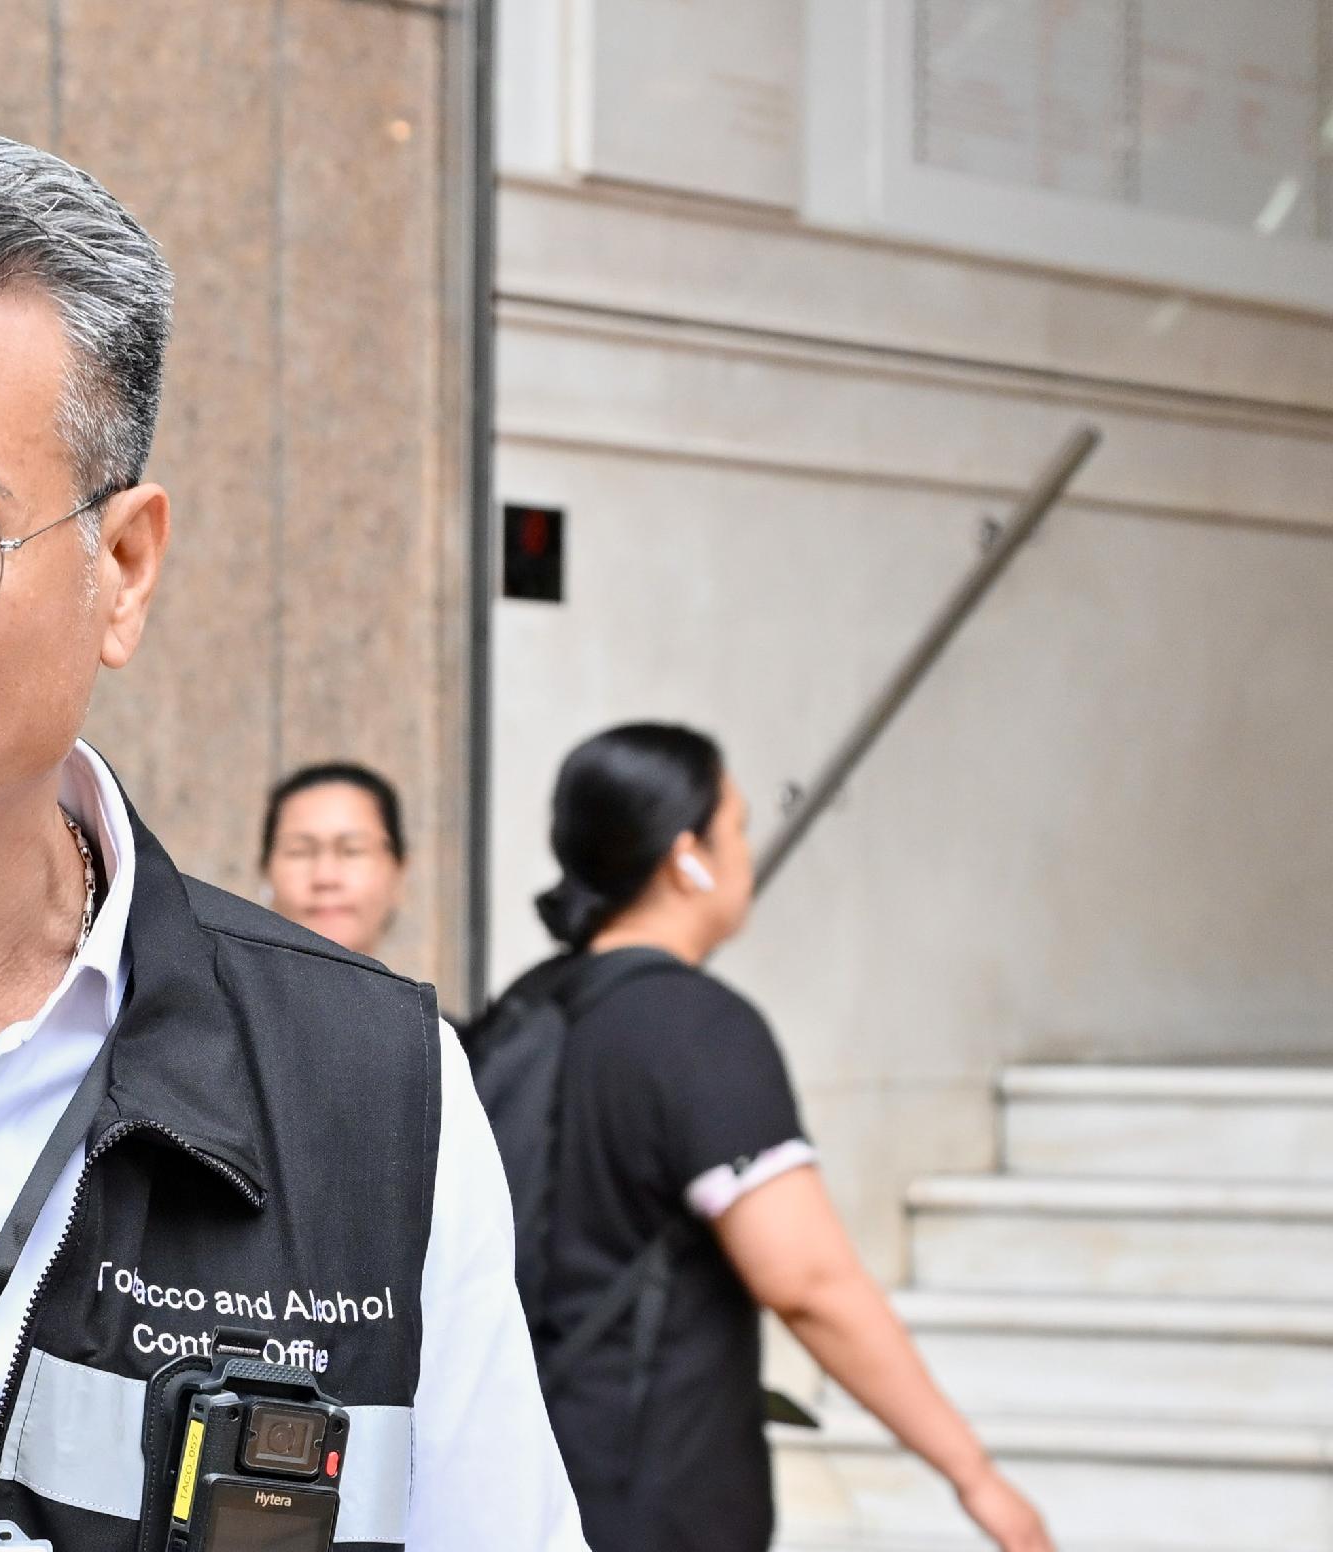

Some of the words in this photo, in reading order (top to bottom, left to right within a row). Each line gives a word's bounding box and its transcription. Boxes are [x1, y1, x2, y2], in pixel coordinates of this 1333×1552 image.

[213, 1290, 275, 1321] and
[132, 1323, 212, 1357] Cont
[254, 1490, 293, 1508] Hytera
